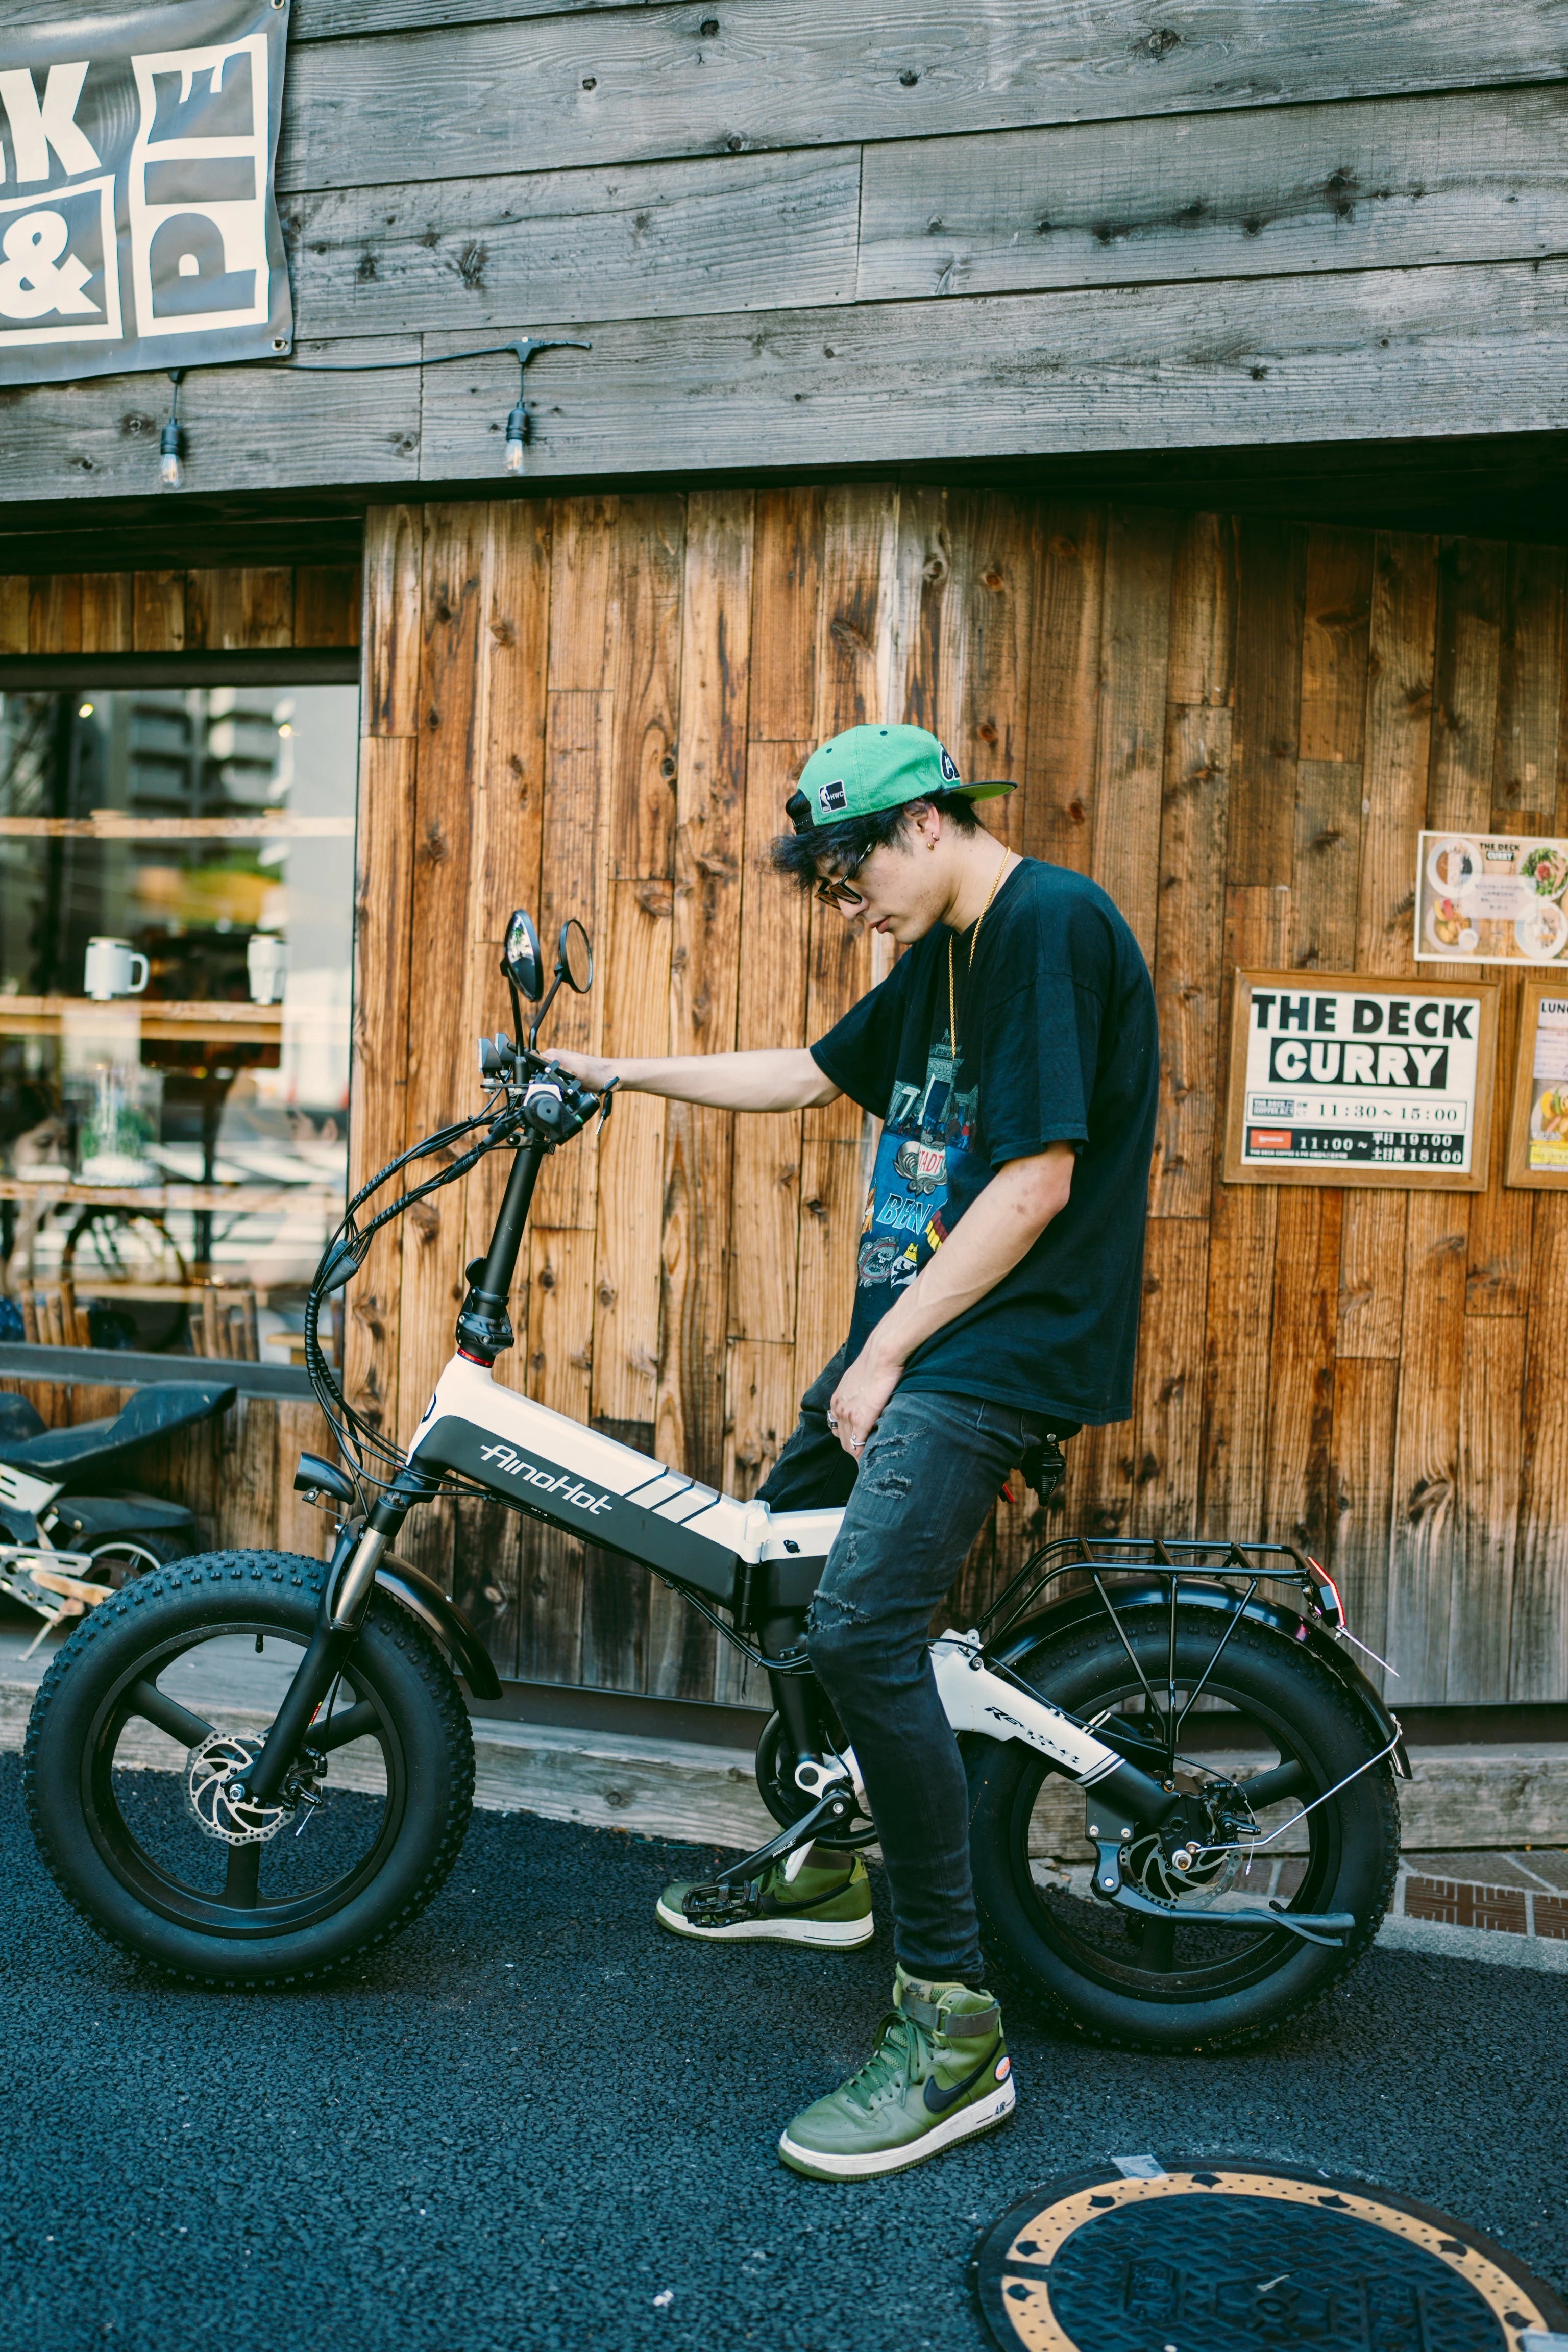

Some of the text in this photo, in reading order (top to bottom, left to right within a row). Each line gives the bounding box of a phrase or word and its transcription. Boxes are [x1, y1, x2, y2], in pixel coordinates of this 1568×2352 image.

[144, 52, 257, 319] PIE
[0, 210, 102, 320] &
[830, 791, 844, 800] HWC
[1252, 994, 1474, 1039] THE DECK
[1541, 1002, 1568, 1014] LUN
[1275, 1040, 1444, 1087] CURRY
[994, 2101, 1006, 2116] AIR
